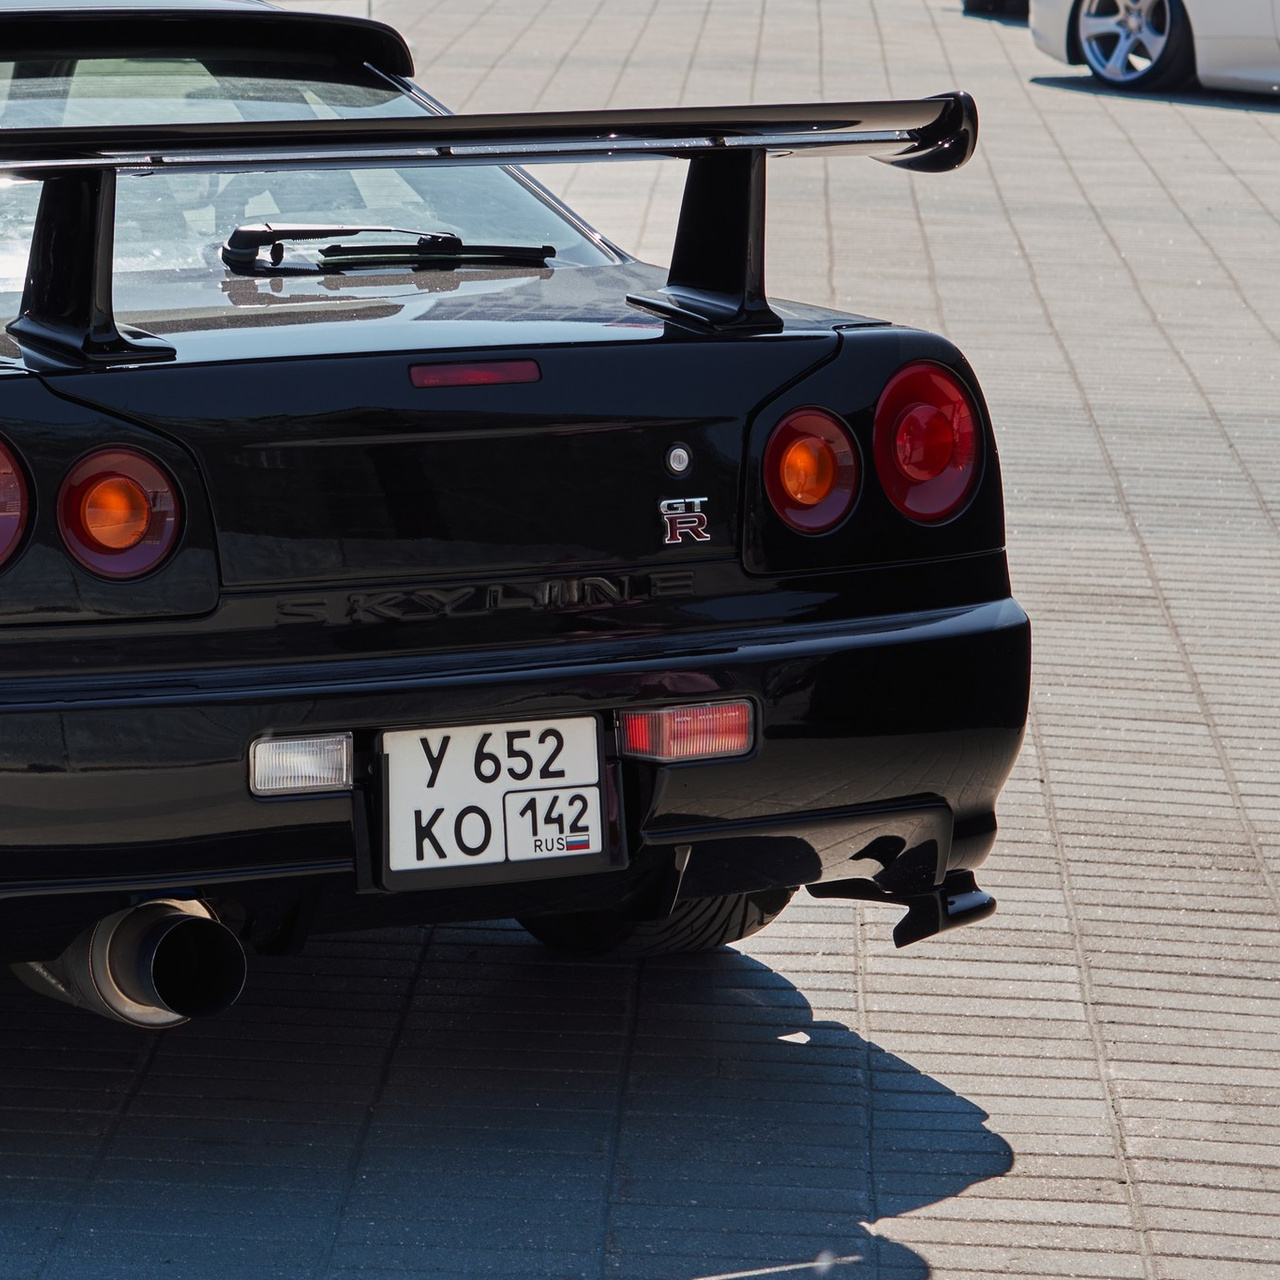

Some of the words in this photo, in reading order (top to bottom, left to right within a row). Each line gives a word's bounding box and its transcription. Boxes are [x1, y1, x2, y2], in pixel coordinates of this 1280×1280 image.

[659, 496, 709, 514] GT
[663, 512, 711, 544] R
[275, 570, 697, 625] SKYLINE
[473, 728, 566, 784] 652
[518, 793, 590, 837] 142
[534, 836, 566, 853] RUS
